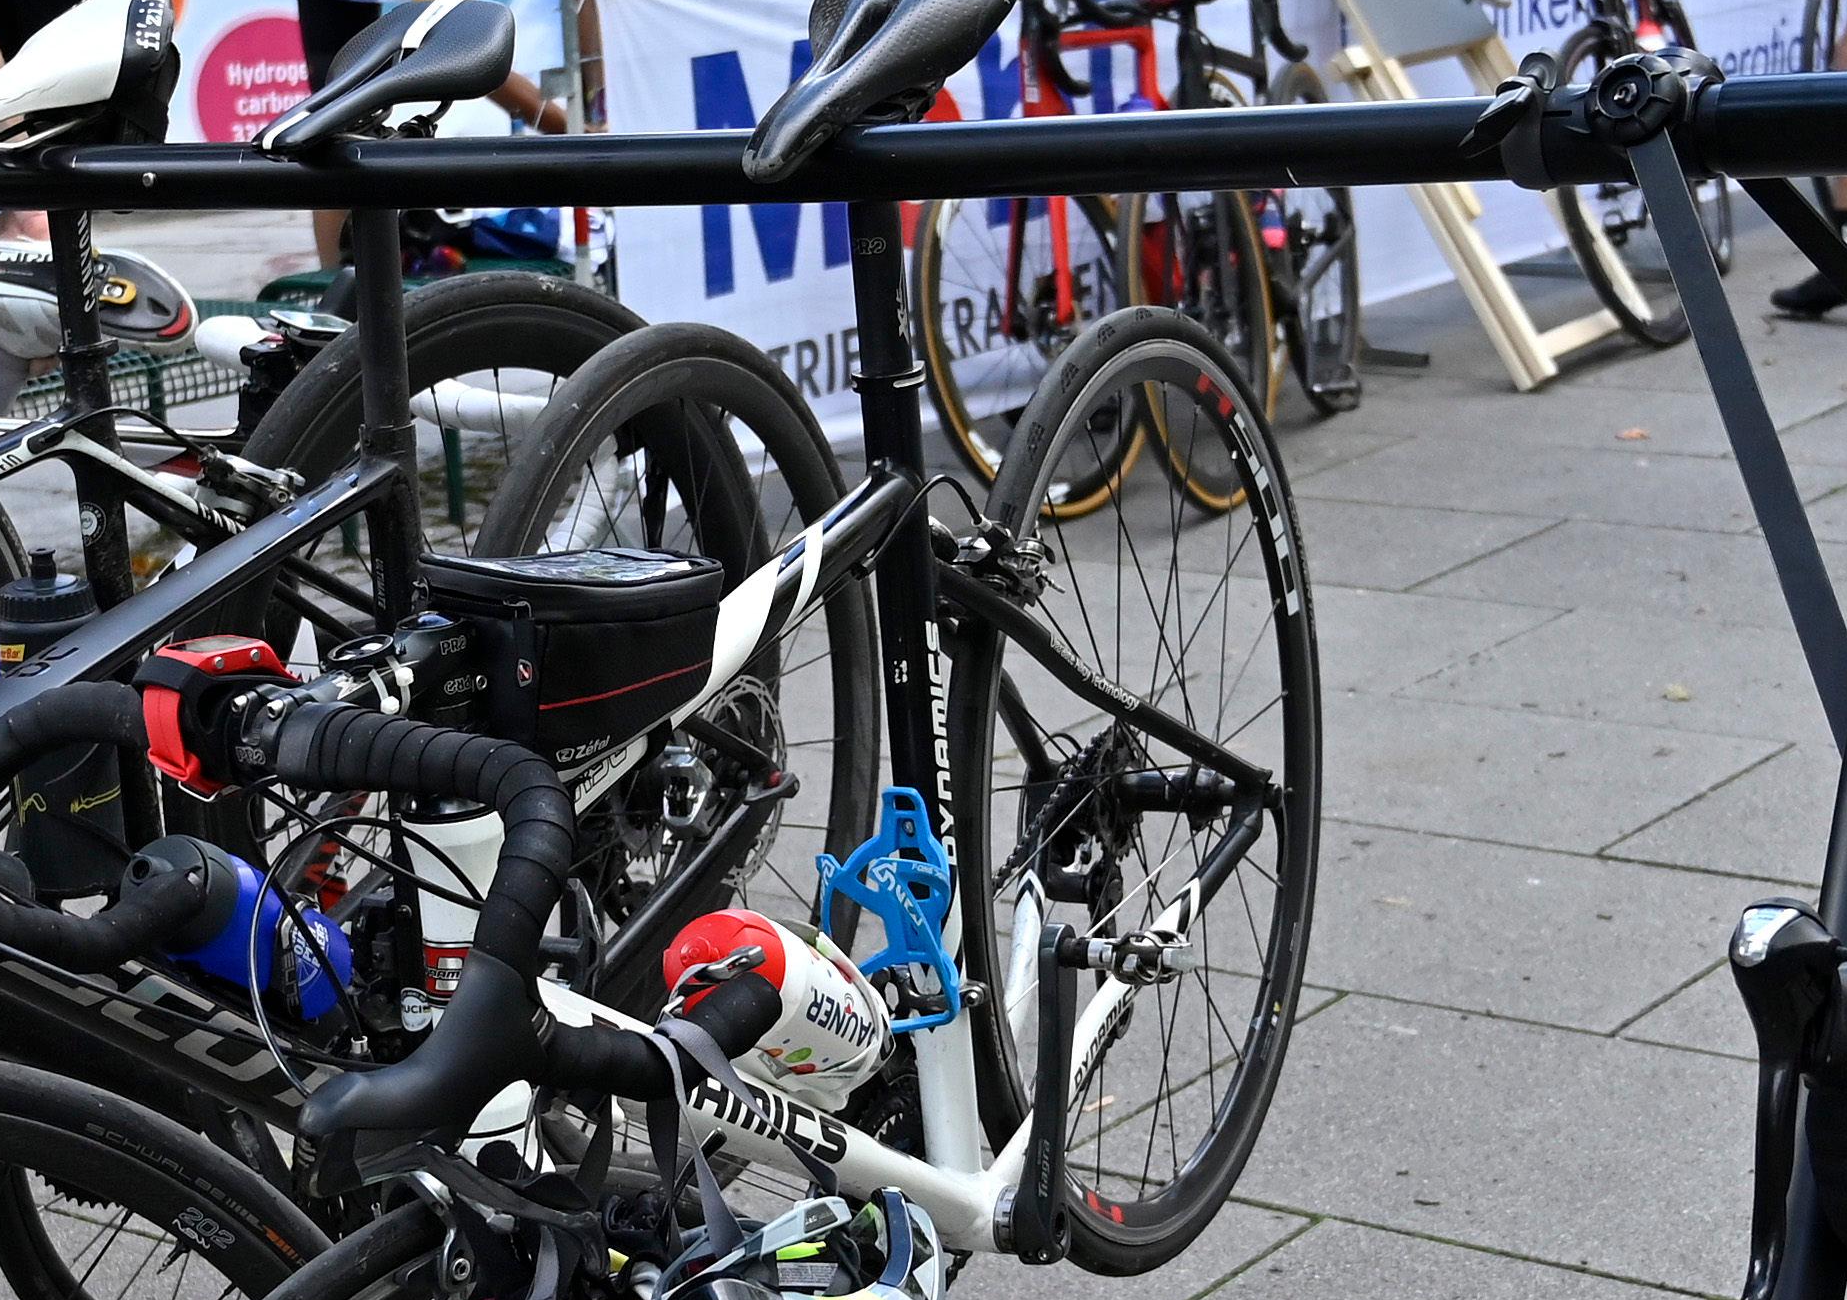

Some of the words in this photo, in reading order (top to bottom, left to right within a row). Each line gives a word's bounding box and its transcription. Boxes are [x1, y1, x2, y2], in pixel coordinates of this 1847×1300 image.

[576, 734, 611, 761] Zéfal
[925, 619, 957, 866] DYNAMICS
[85, 1121, 226, 1201] SCHWALBE
[687, 1077, 849, 1165] AMICS
[177, 1206, 237, 1251] 202
